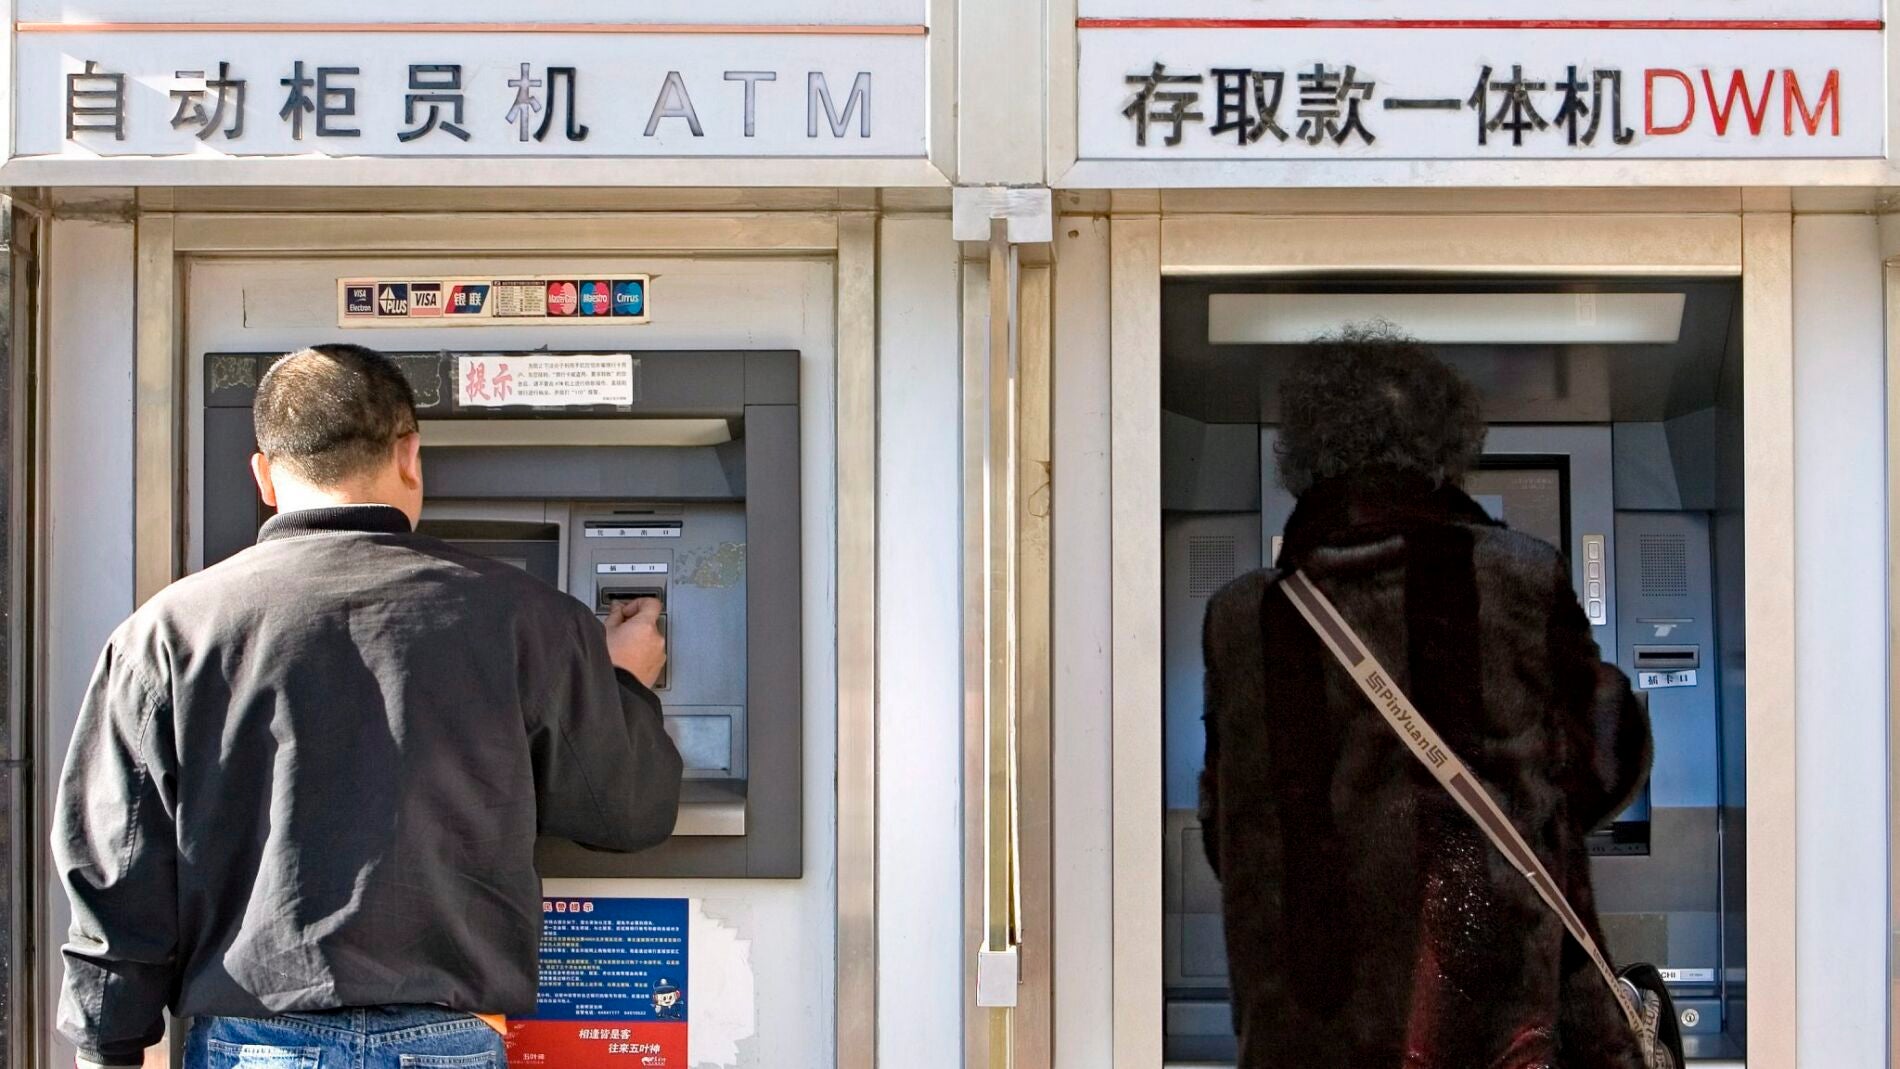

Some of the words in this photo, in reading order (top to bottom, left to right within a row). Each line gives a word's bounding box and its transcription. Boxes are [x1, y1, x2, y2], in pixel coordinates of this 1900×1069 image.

[65, 60, 591, 143] 自动柜员机
[643, 70, 873, 139] ATM
[1122, 62, 1636, 148] 存取款一体机
[1643, 68, 1841, 136] DWM
[353, 290, 366, 298] VISA
[414, 292, 437, 306] VISA
[454, 292, 482, 306] 银联
[583, 293, 608, 303] Maestro
[617, 293, 640, 304] Cirrus
[349, 303, 371, 312] Electron
[386, 299, 408, 314] PLUS
[465, 360, 513, 402] 提示
[1648, 673, 1688, 686] 插卡口
[579, 1028, 631, 1040] 相逢皆是客
[609, 1044, 661, 1055] 往来五叶神
